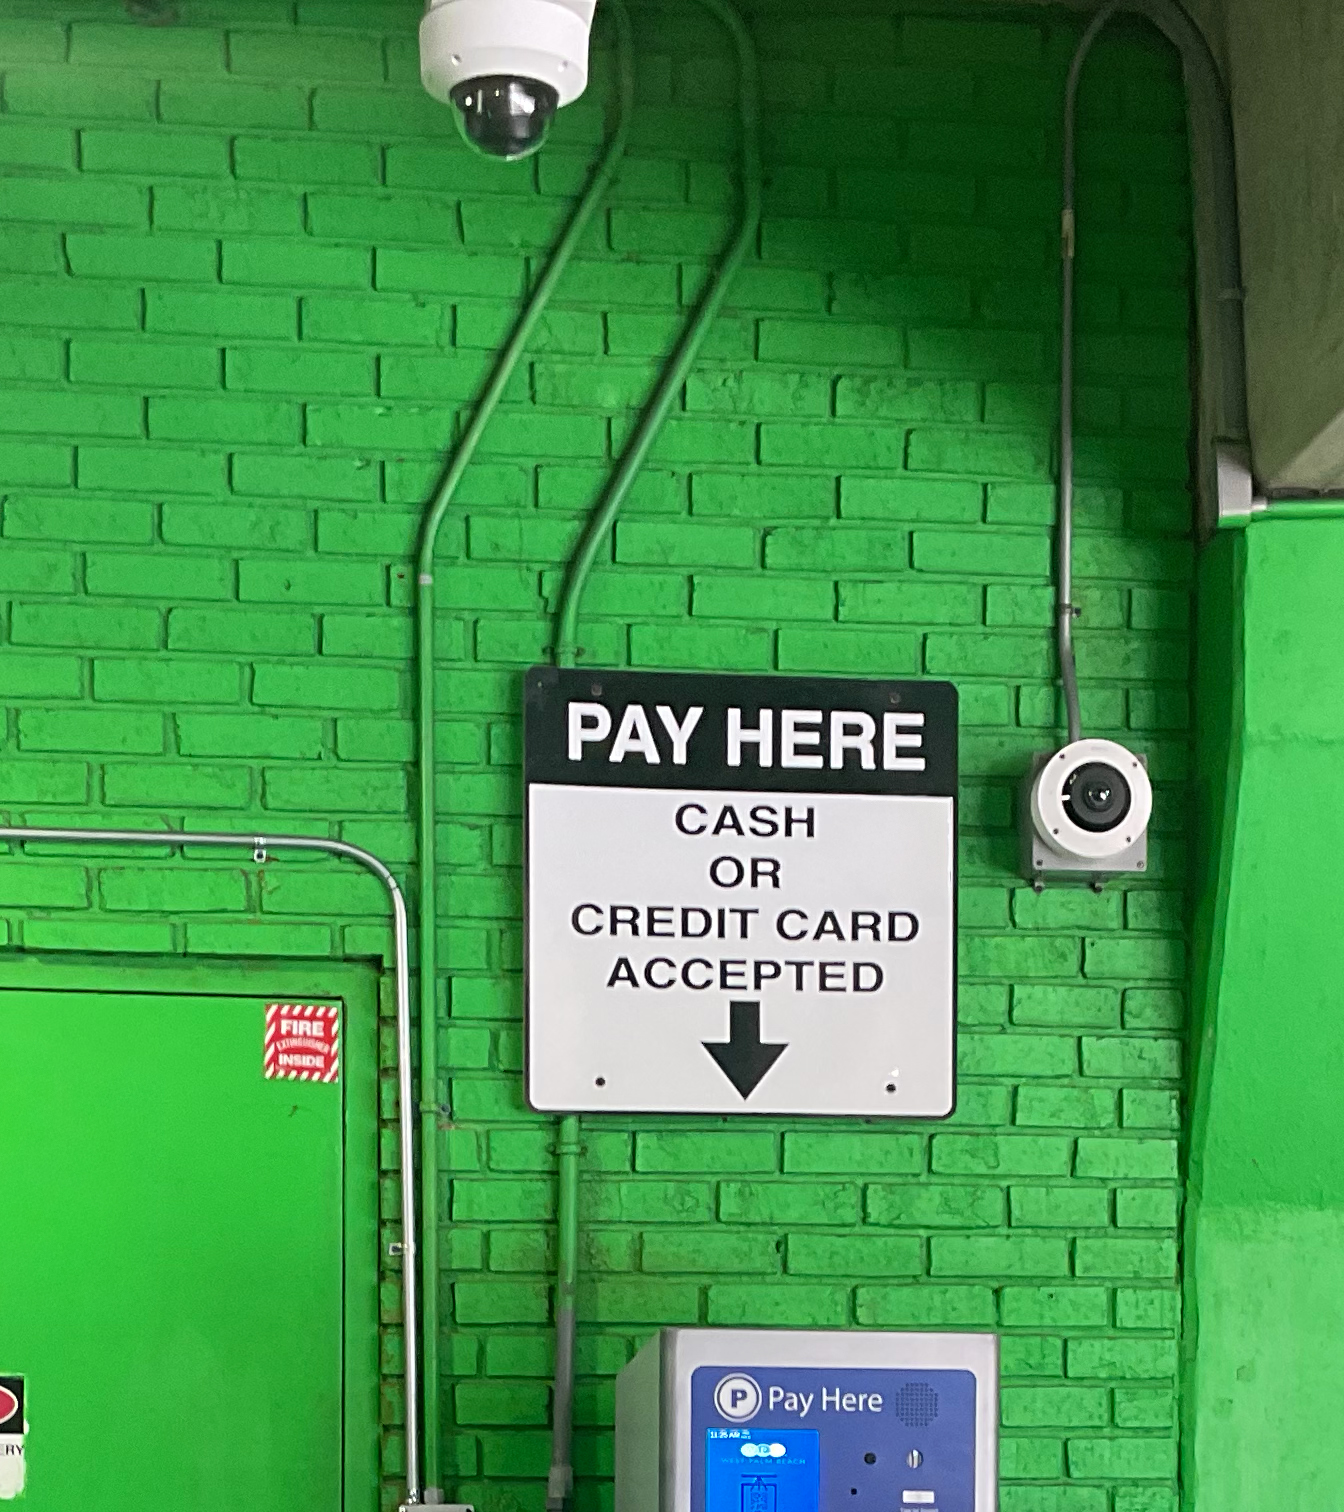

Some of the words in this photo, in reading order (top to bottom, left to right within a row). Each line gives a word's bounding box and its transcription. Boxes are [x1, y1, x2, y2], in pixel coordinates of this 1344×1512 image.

[567, 701, 704, 766] PAY
[726, 707, 926, 772] HERE
[674, 803, 816, 838] CASH
[709, 855, 782, 889] OR
[570, 903, 759, 940] CREDIT
[775, 909, 920, 943] CARD
[606, 957, 885, 993] ACCEPTED
[280, 1019, 325, 1037] FIRE
[278, 1053, 325, 1069] INSIDE
[730, 1388, 748, 1409] P
[768, 1385, 814, 1418] Pay
[822, 1387, 883, 1413] Here
